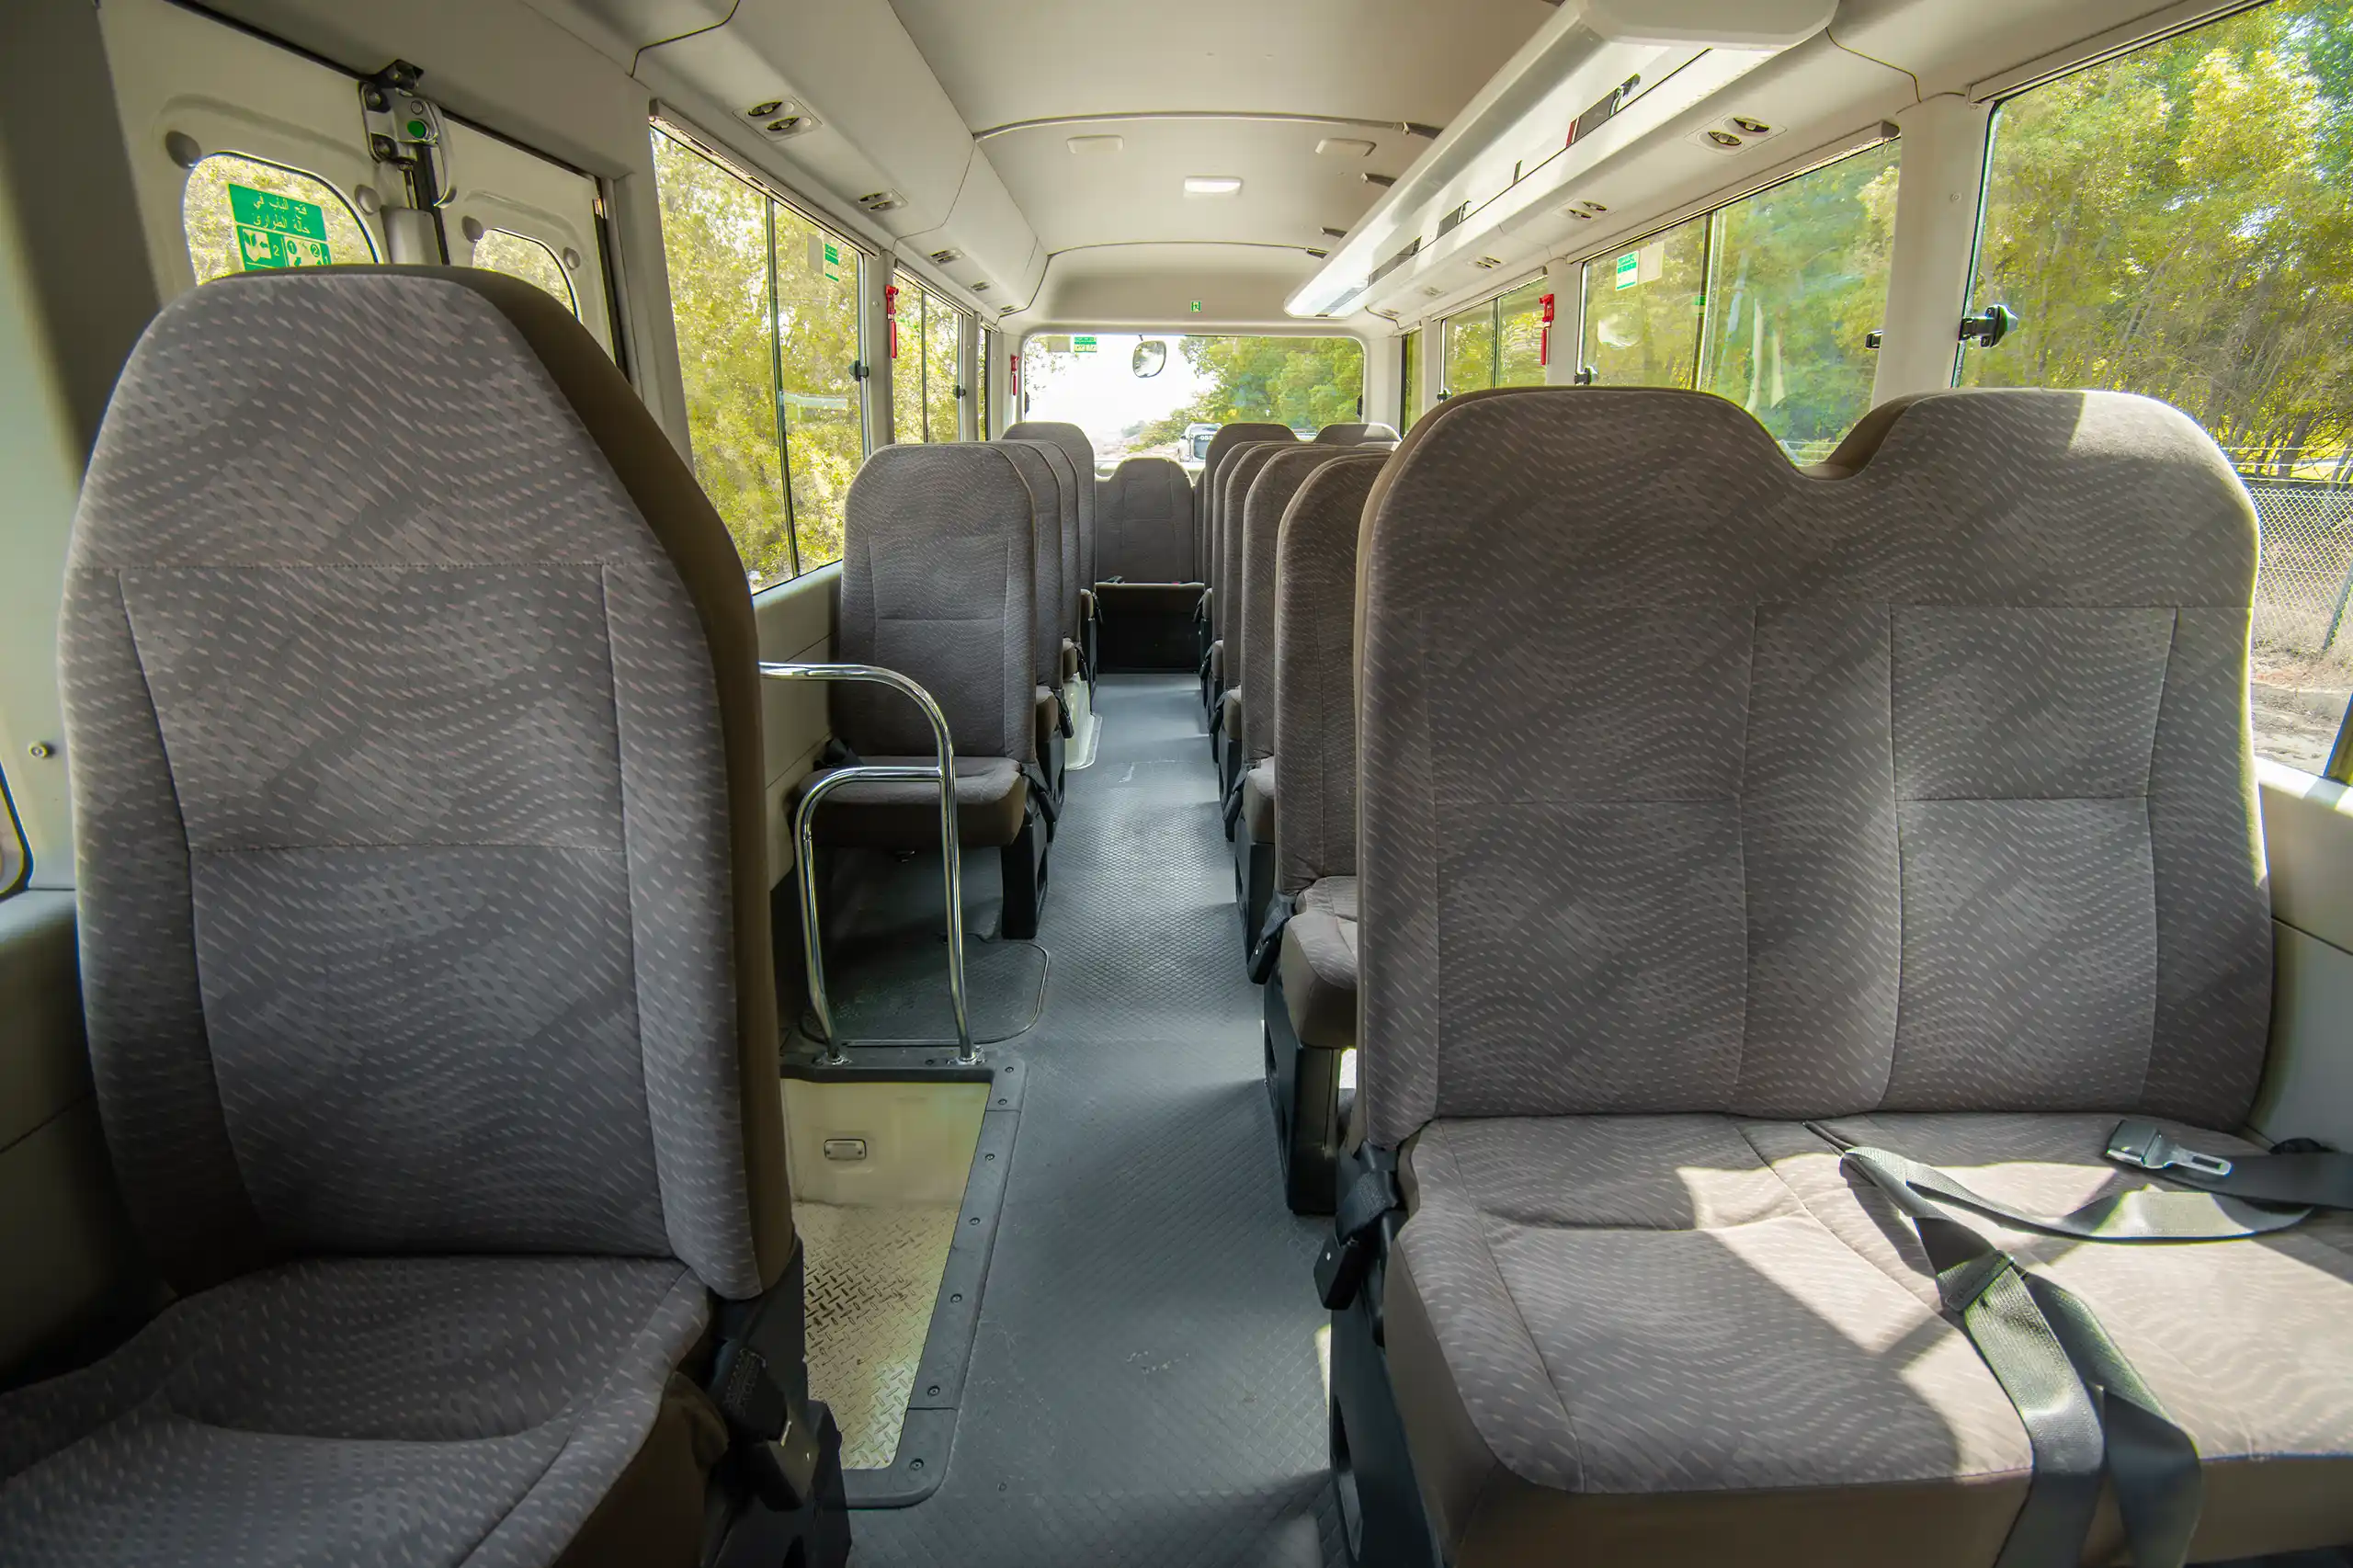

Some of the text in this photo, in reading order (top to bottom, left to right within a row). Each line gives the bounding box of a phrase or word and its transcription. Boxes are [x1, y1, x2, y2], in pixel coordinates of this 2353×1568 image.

[253, 192, 265, 210] في
[268, 197, 290, 212] الباب
[273, 244, 280, 256] 2
